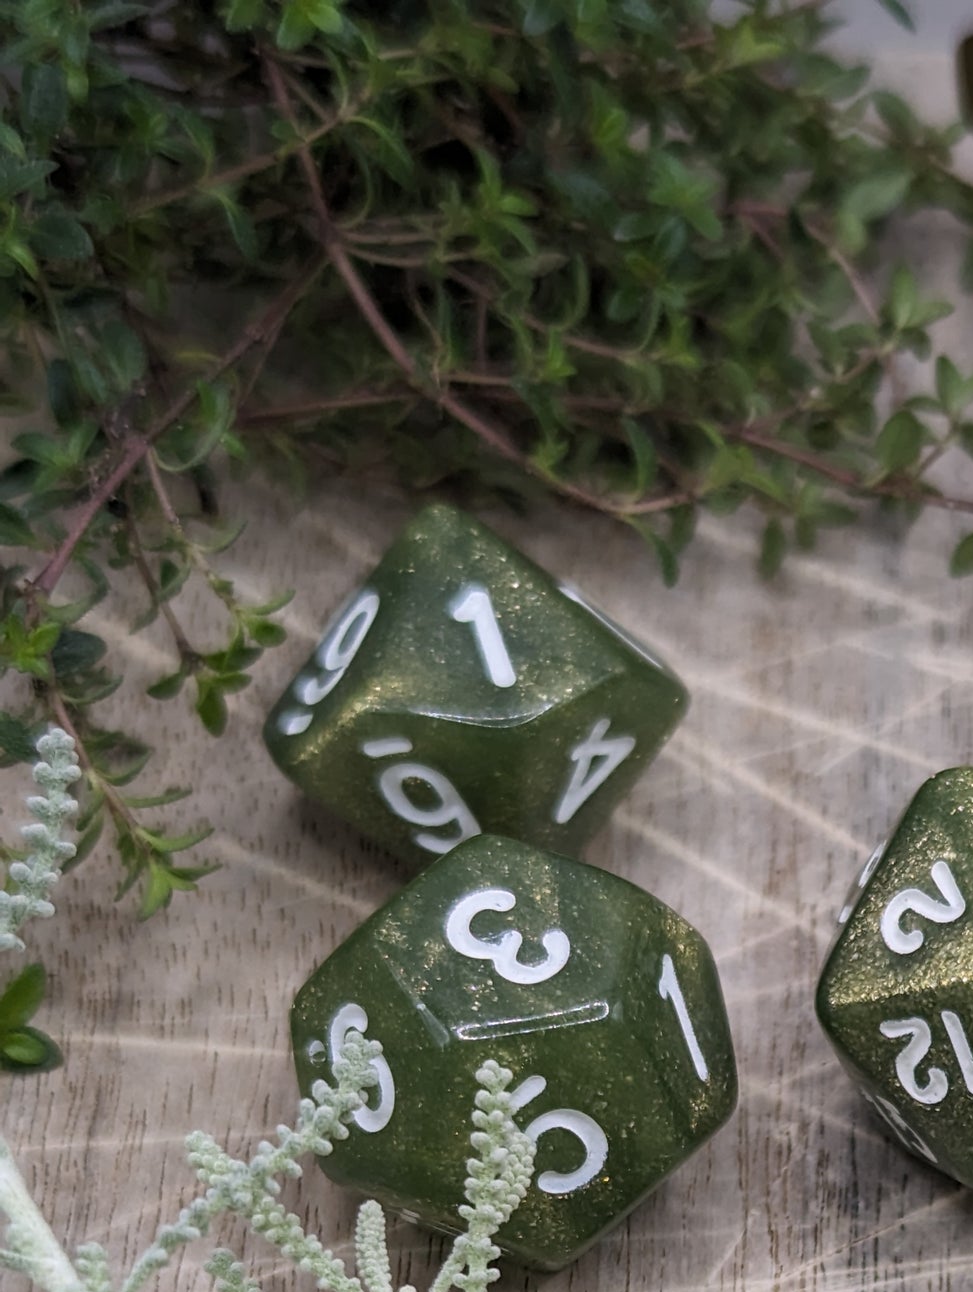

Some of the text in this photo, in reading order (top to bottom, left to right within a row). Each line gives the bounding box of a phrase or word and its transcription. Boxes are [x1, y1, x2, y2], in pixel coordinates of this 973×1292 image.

[451, 587, 517, 688] 1
[555, 718, 636, 824] 4
[446, 888, 571, 985] 3
[880, 861, 966, 954] 2
[659, 953, 709, 1082] 1
